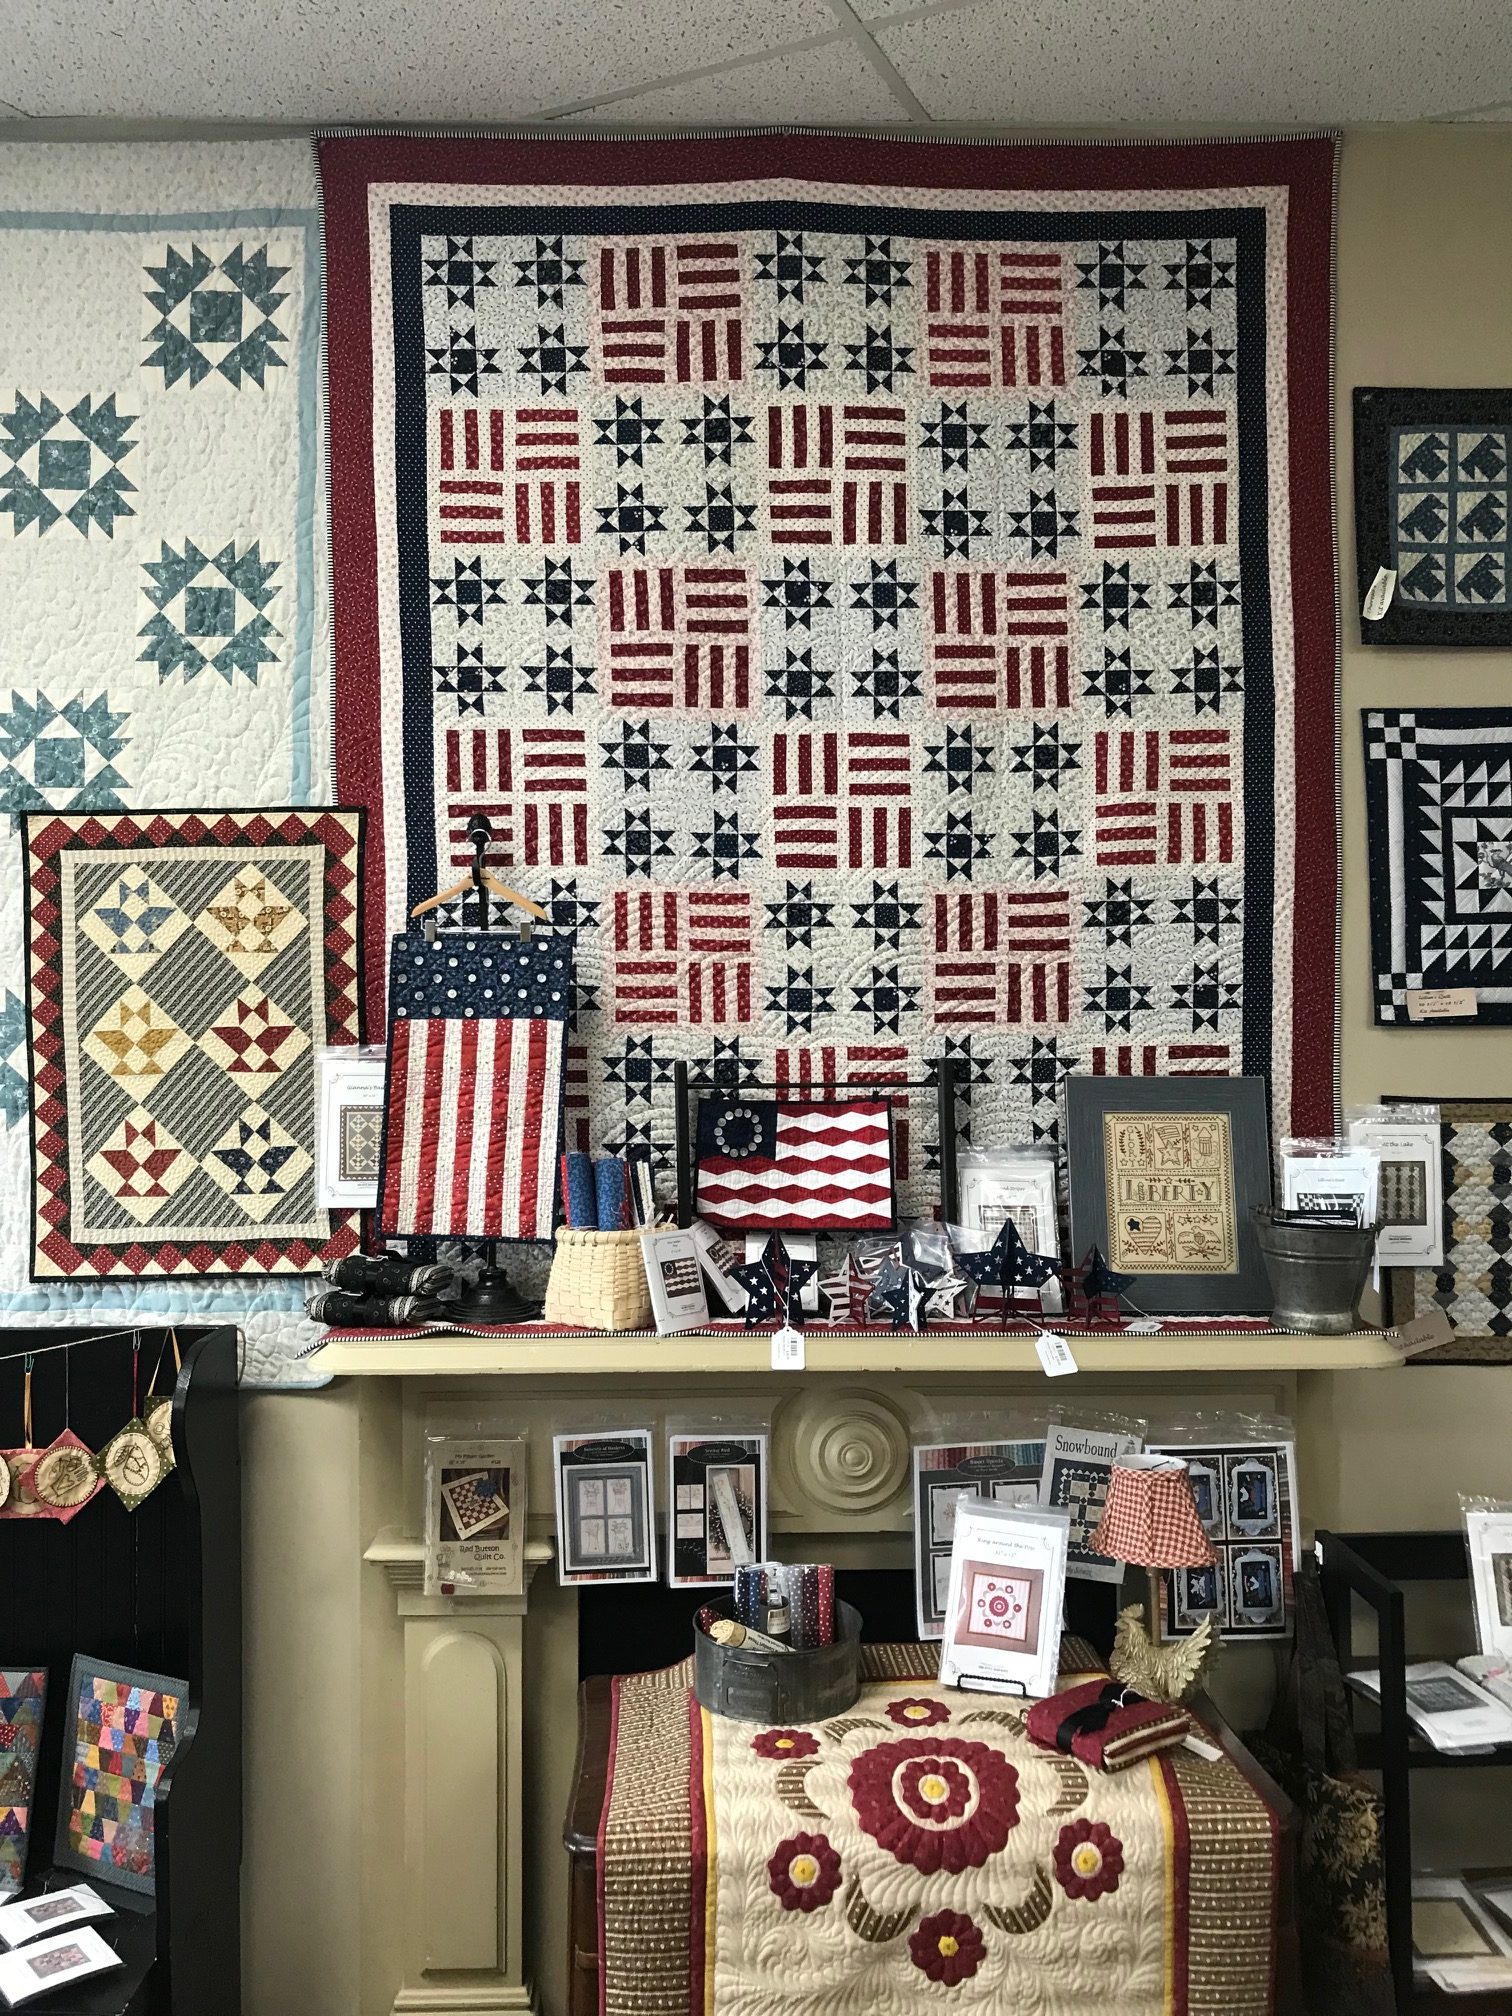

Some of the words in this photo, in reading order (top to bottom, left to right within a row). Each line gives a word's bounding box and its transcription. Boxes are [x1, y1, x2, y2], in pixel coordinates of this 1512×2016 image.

[1126, 1125, 1137, 1168] GLORY
[1124, 1178, 1216, 1204] LIBERTY
[1055, 1434, 1118, 1458] Snowbound
[474, 1553, 492, 1561] Quilt
[475, 1545, 499, 1553] Button
